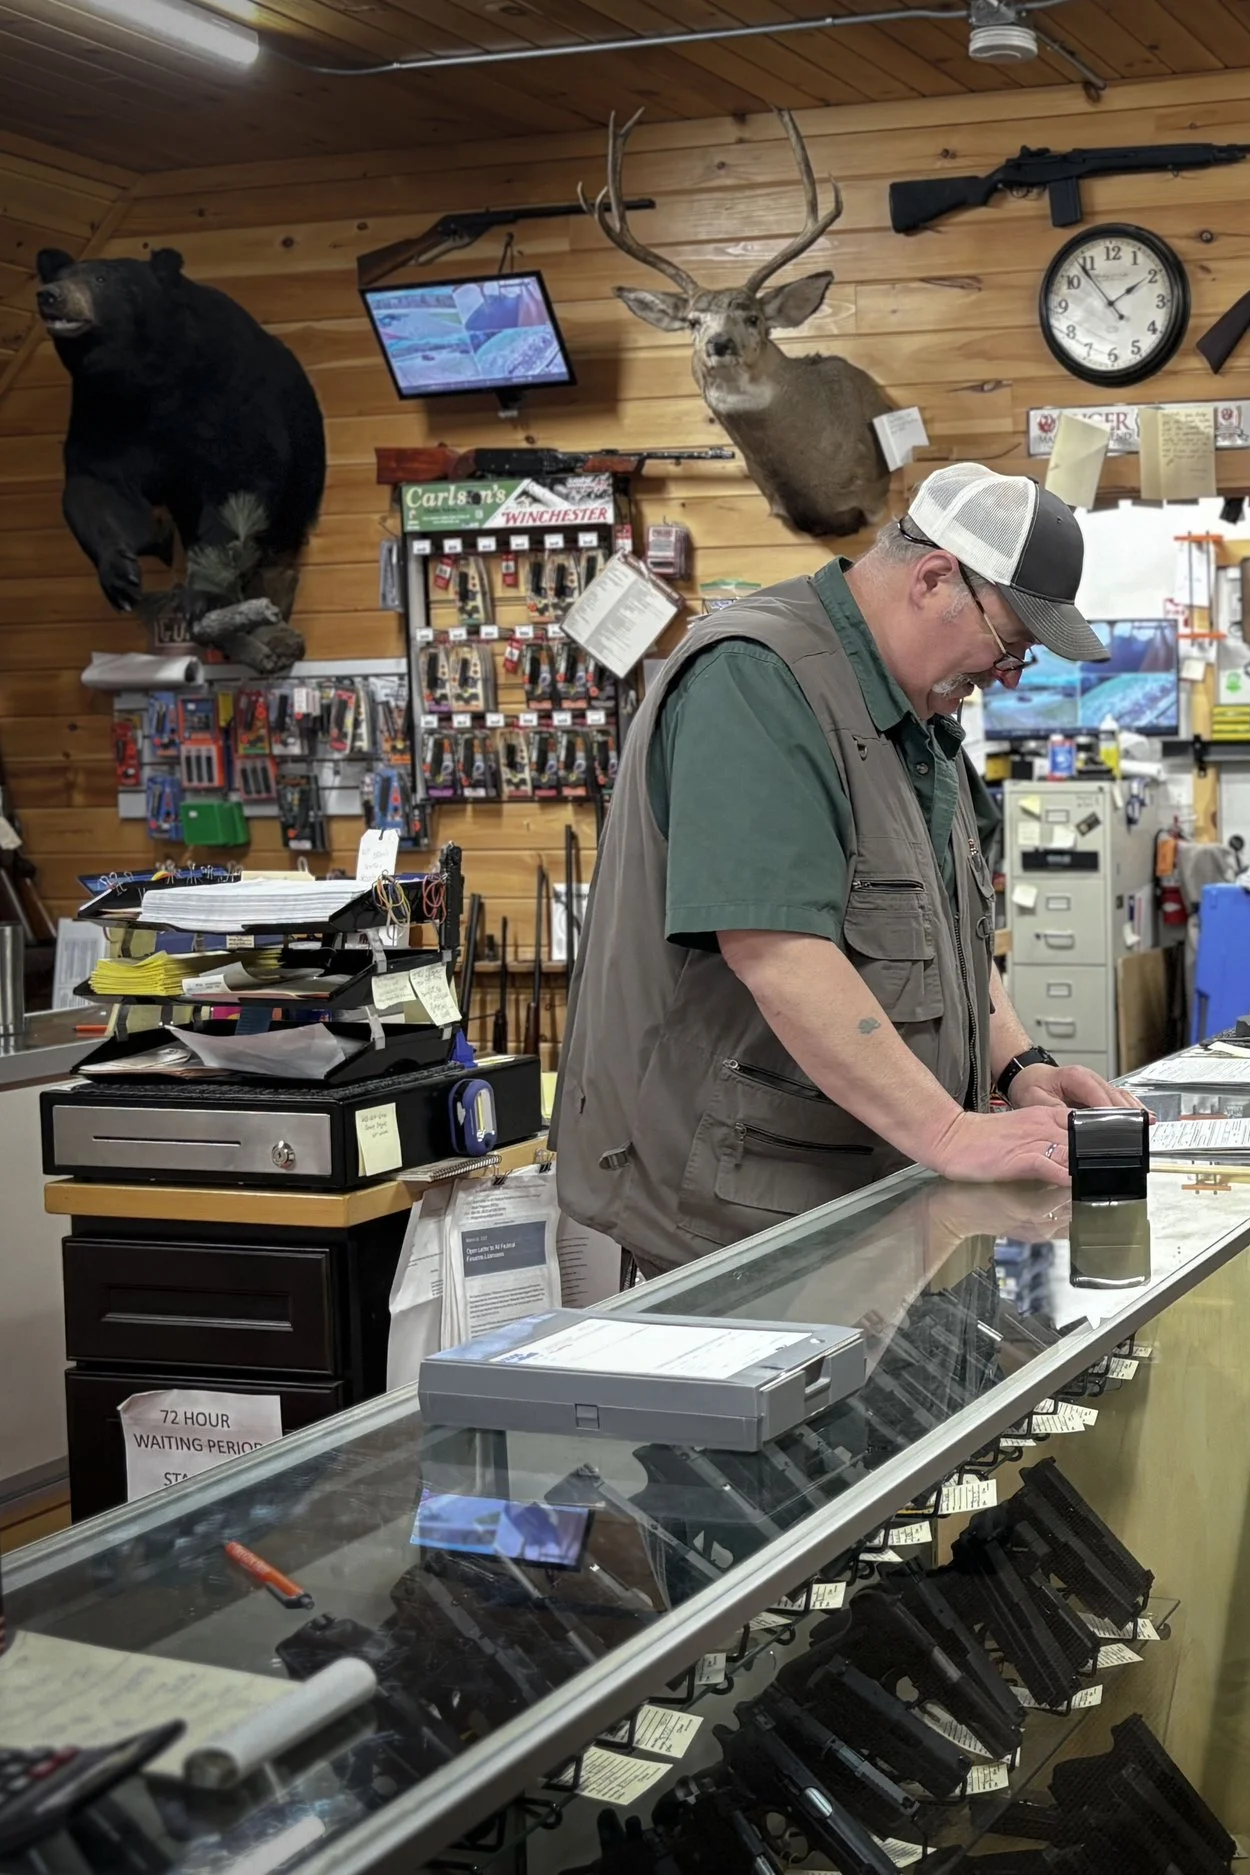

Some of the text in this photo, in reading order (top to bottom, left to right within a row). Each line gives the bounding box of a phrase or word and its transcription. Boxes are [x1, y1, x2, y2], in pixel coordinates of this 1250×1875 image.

[1104, 246, 1122, 261] 12
[1131, 250, 1139, 266] 1
[1082, 255, 1096, 271] 11
[1066, 275, 1081, 290] 10
[1148, 269, 1158, 284] 2
[1058, 299, 1069, 314] 9
[1156, 294, 1166, 309] 3
[1066, 324, 1077, 340] 8
[1147, 320, 1158, 335] 4
[1084, 342, 1093, 357] 7
[1108, 347, 1118, 362] 6
[1131, 340, 1141, 355] 5
[406, 484, 506, 508] Carlsn's
[501, 507, 608, 526] WINCHESTER
[160, 1410, 231, 1429] 72 HOUR
[133, 1433, 203, 1452] WAITING
